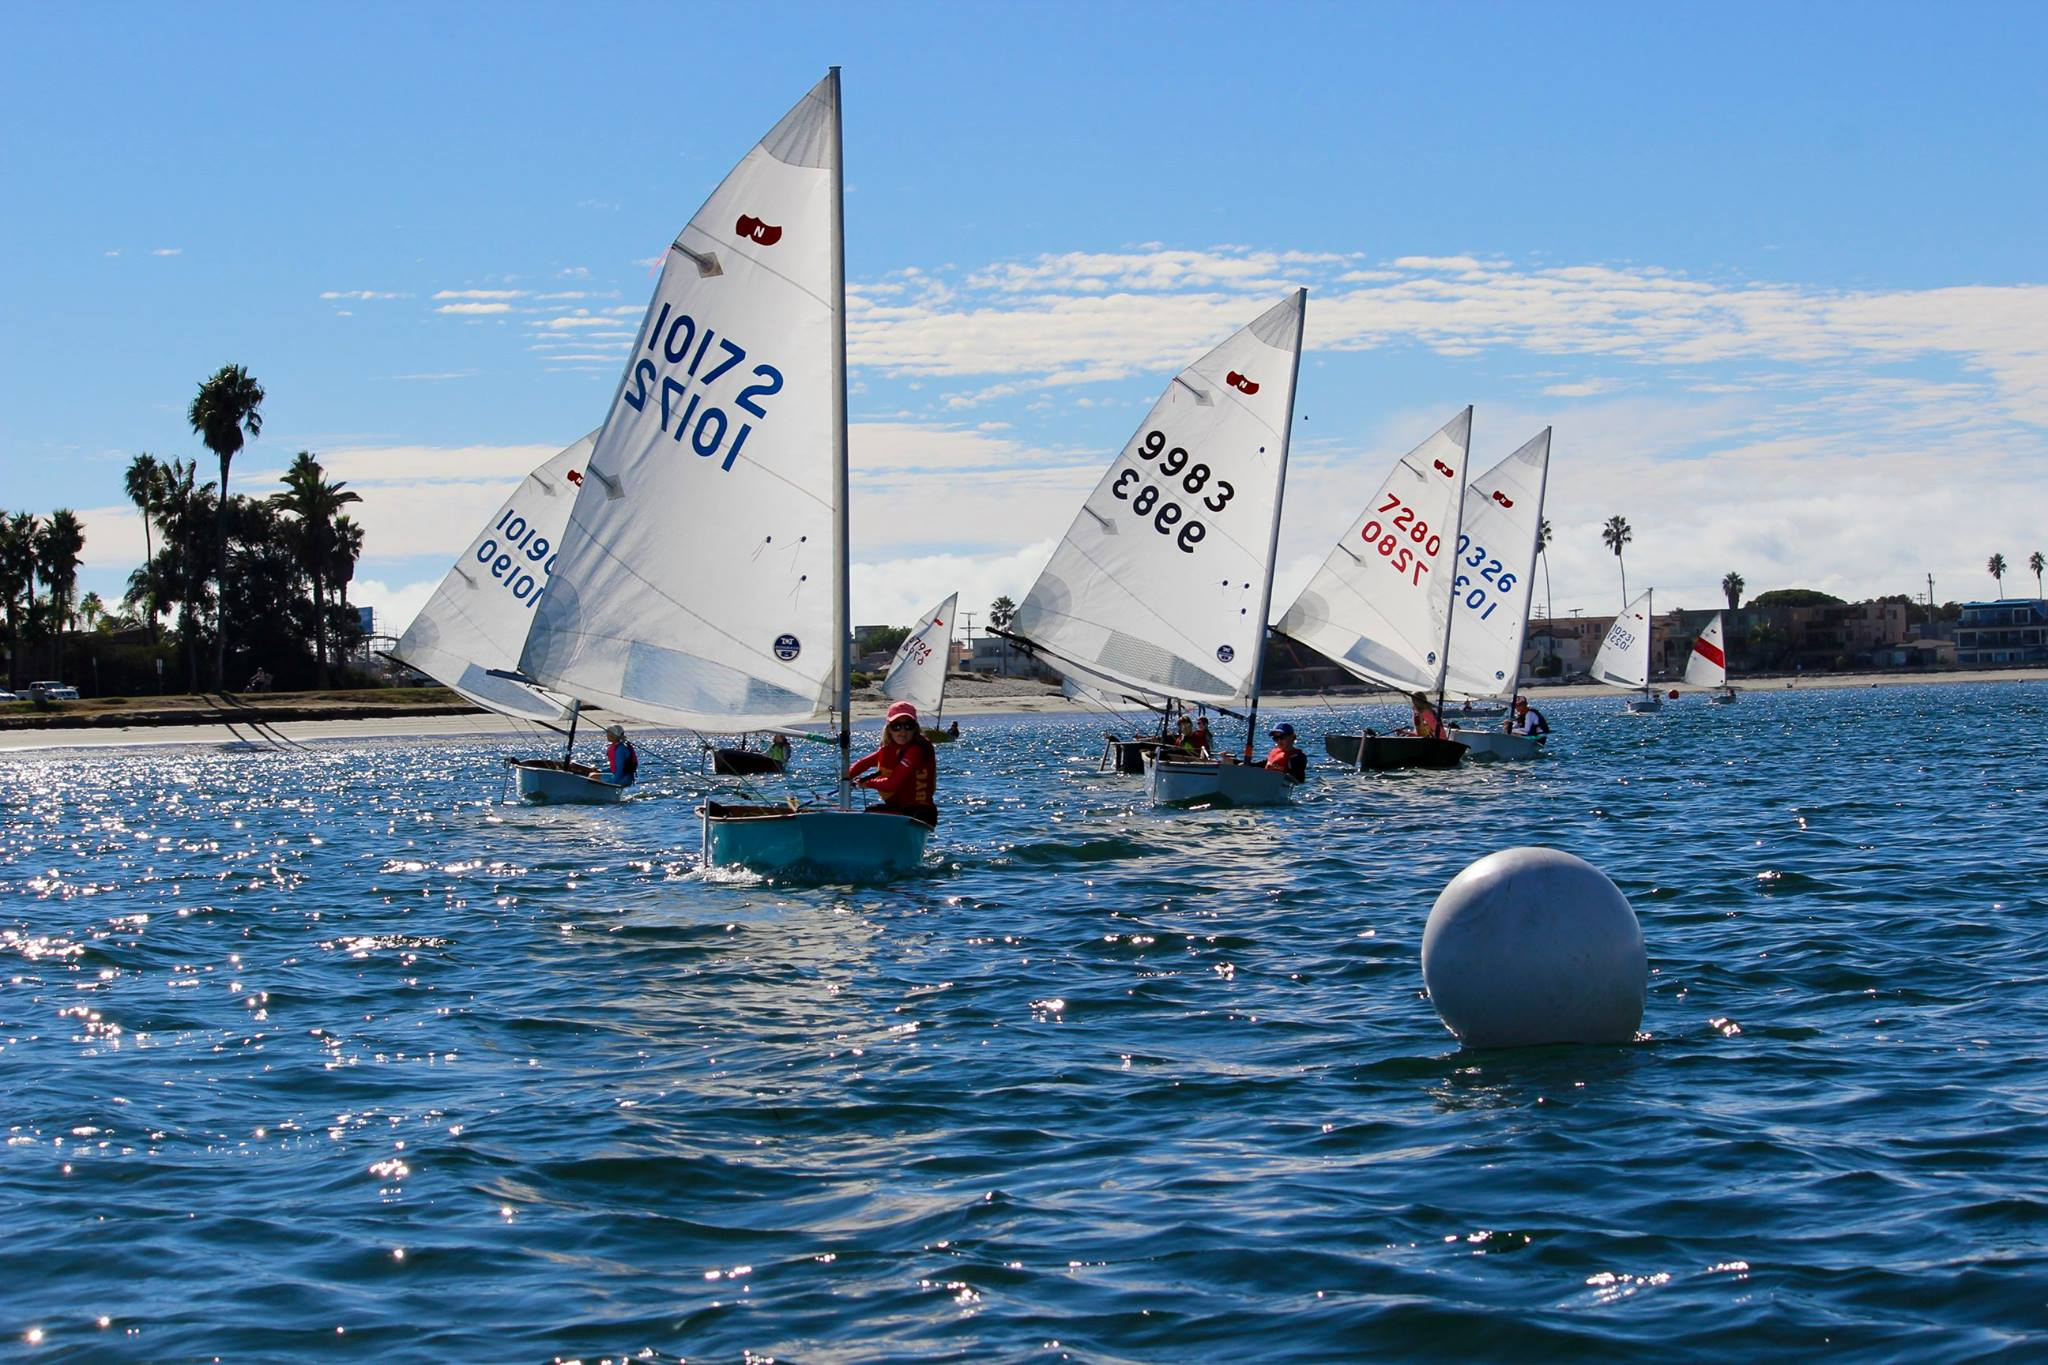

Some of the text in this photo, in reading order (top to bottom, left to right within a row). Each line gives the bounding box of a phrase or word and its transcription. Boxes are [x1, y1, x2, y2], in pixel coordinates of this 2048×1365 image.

[648, 302, 784, 420] 10172
[1138, 430, 1235, 513] 9983
[1377, 493, 1441, 557] 7280
[1457, 534, 1517, 593] 0326
